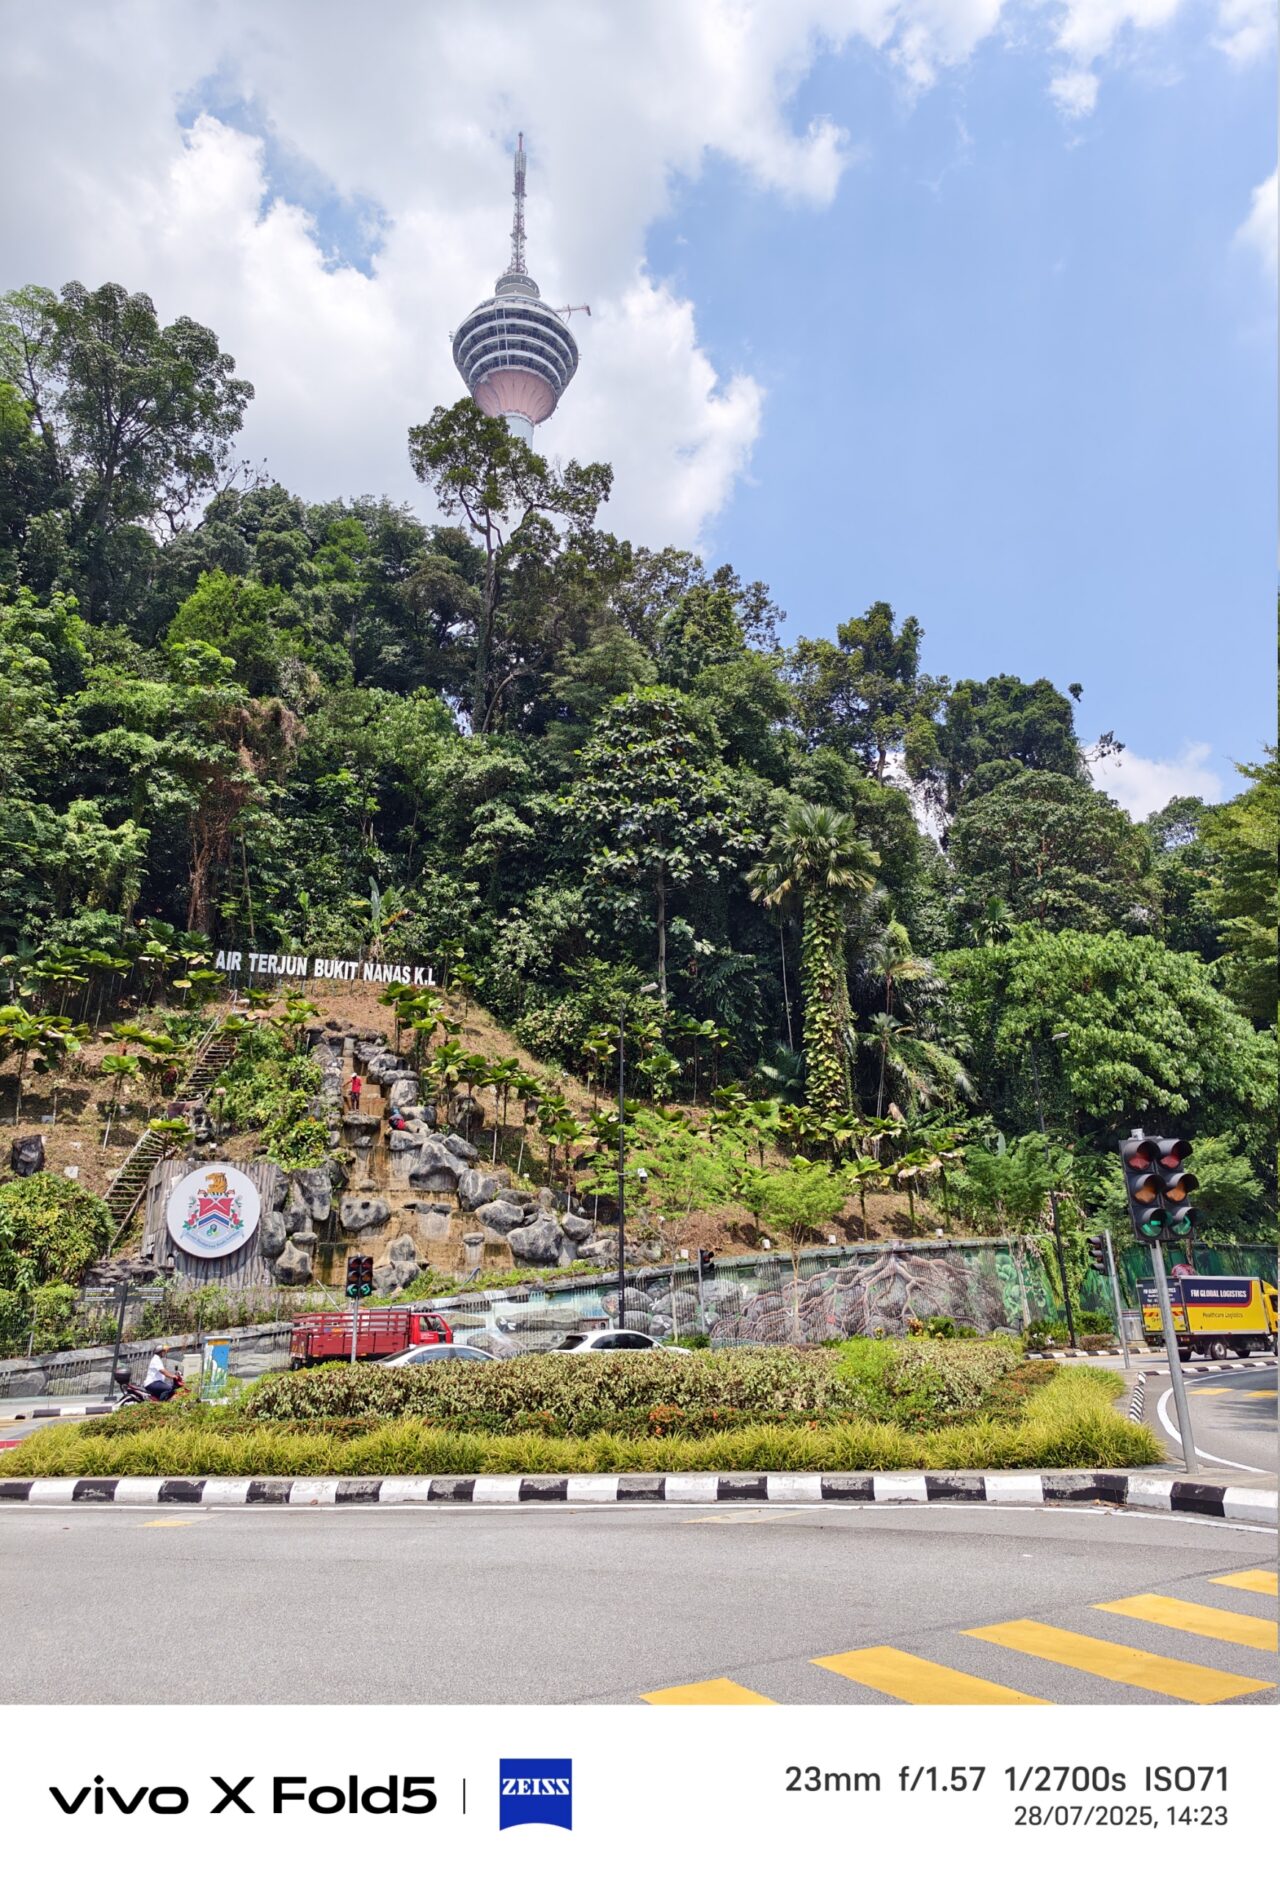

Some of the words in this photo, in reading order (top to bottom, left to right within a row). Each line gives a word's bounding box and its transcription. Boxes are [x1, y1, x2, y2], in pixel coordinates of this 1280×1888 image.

[215, 950, 241, 970] AIR
[249, 953, 308, 976] TERJUN
[314, 958, 359, 980] BUKIT
[363, 963, 411, 983] NANAS
[1190, 1289, 1199, 1298] FM
[1200, 1289, 1219, 1298] GLOBAL
[1220, 1290, 1247, 1298] LOGISTICS
